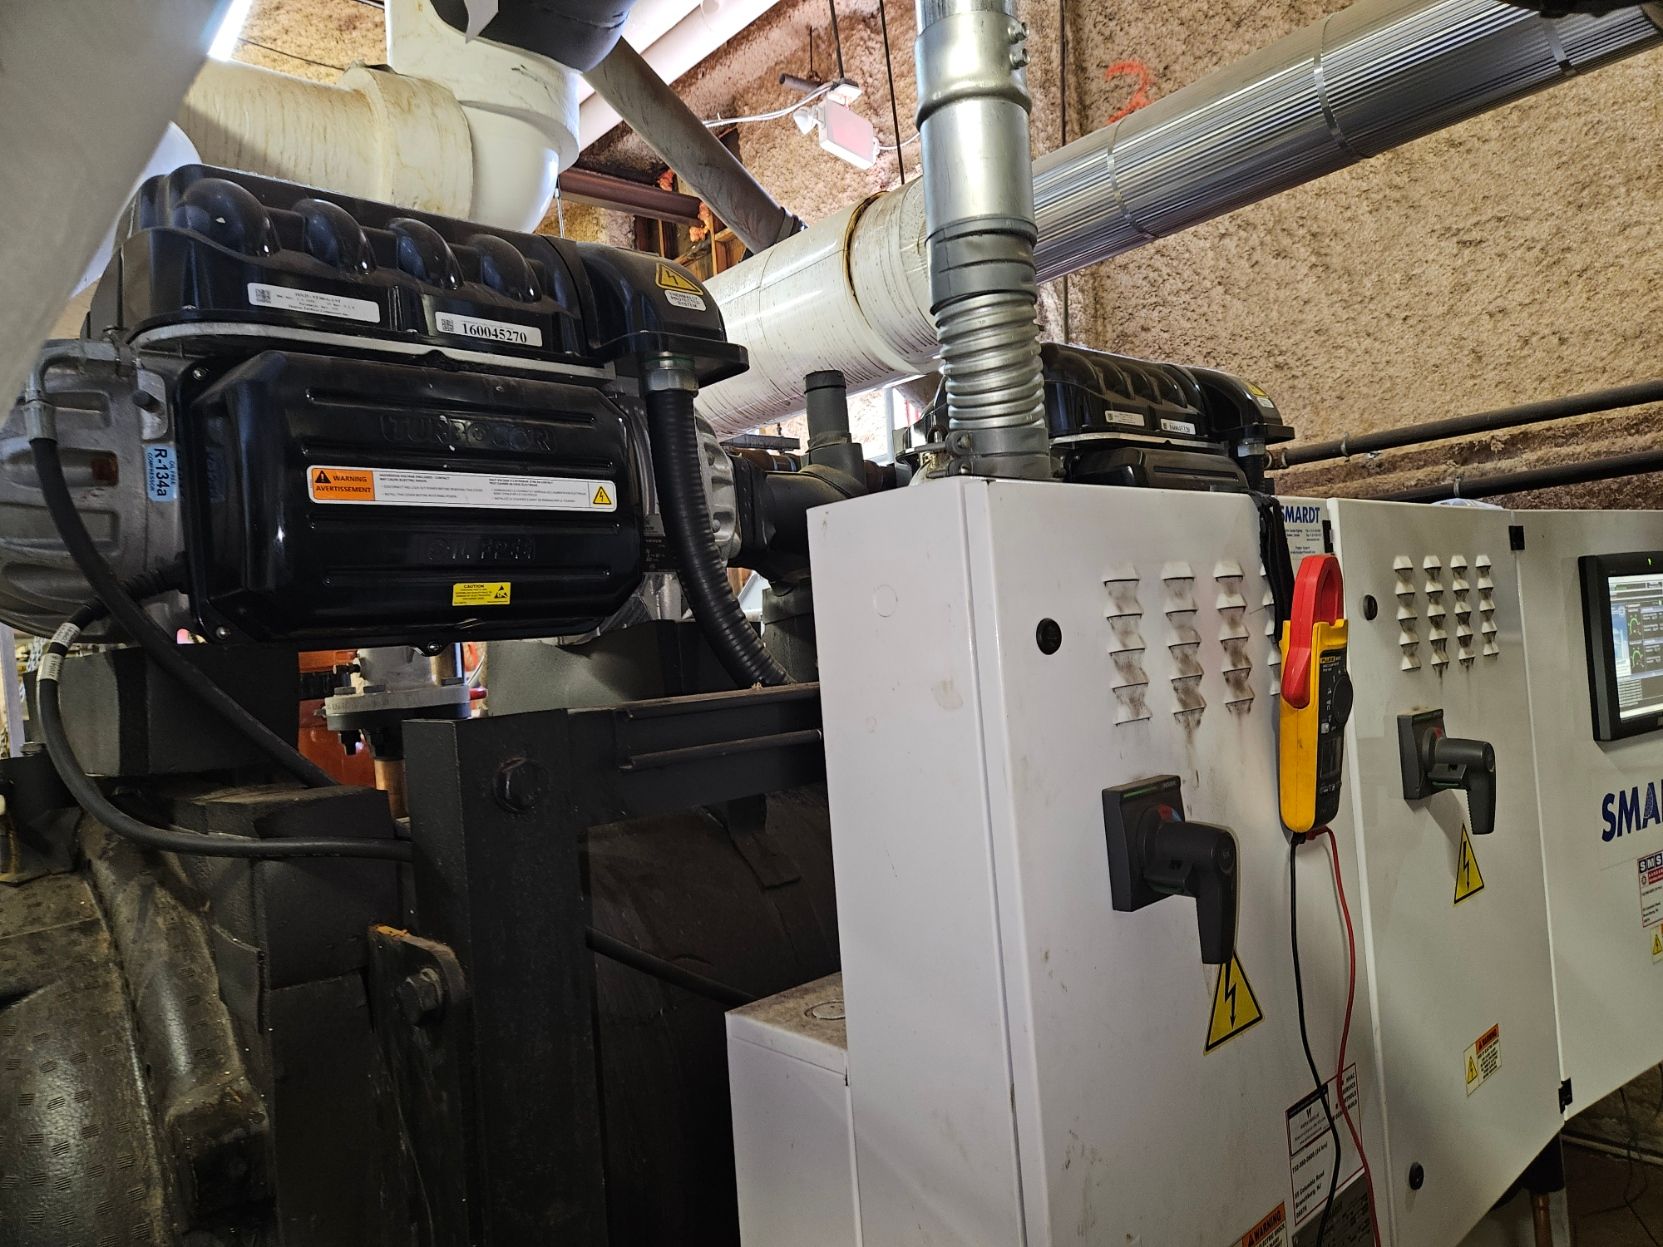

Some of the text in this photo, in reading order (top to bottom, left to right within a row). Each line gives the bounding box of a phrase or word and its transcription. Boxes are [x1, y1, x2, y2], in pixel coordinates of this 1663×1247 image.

[462, 323, 527, 344] 160045270
[154, 448, 170, 497] R-134a
[332, 475, 368, 483] WARNING
[316, 485, 372, 493] AVERTISSEMENT
[1602, 780, 1663, 843] SMA
[1253, 1209, 1281, 1242] WARNING
